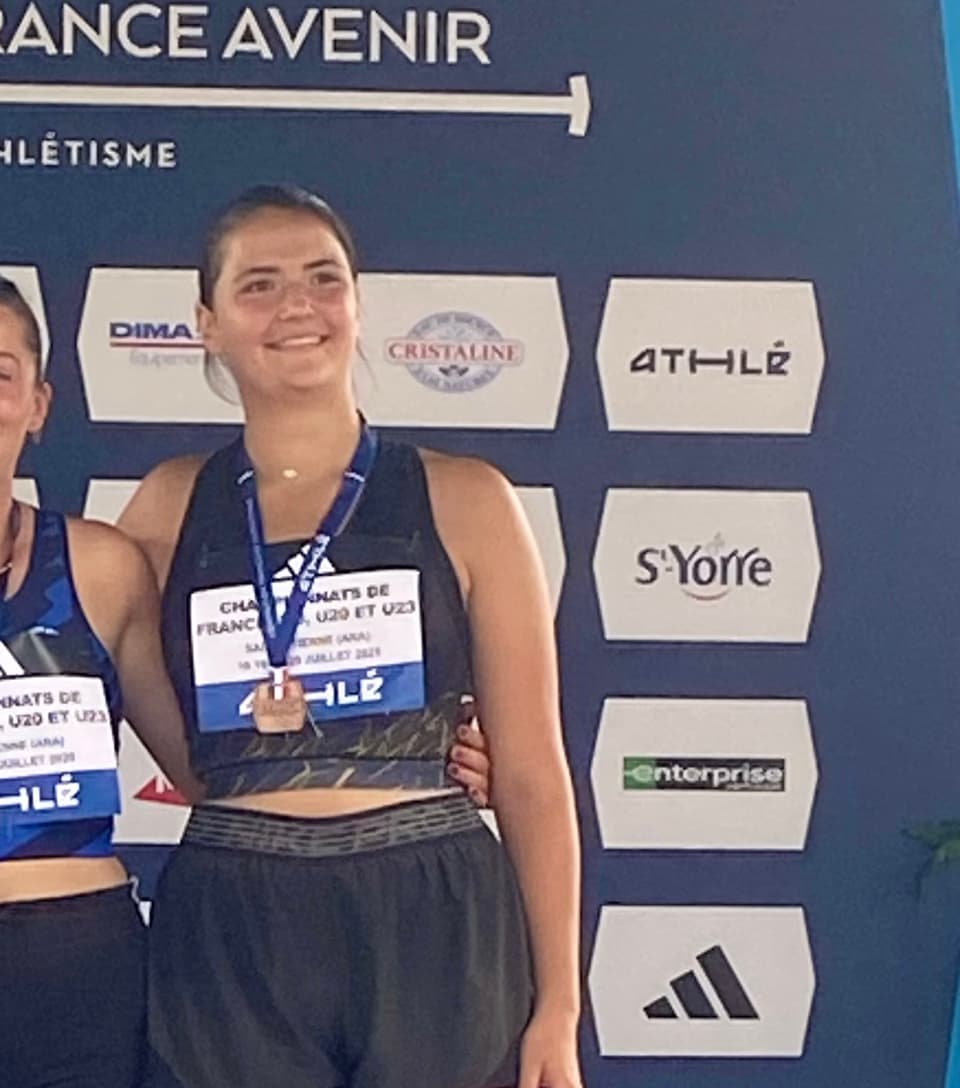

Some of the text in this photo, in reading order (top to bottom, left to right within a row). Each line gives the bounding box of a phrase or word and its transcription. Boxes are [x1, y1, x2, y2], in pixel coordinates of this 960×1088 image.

[222, 6, 492, 65] AVENIR
[388, 342, 516, 362] CRISTALINE
[629, 339, 792, 376] ATHLÉ
[366, 584, 390, 599] DE
[197, 617, 257, 637] FRANC
[315, 606, 349, 624] U20
[355, 604, 377, 619] ET
[382, 600, 416, 616] U23
[59, 691, 82, 705] DE
[8, 712, 44, 728] U20
[48, 709, 70, 724] ET
[625, 762, 783, 788] enterprise
